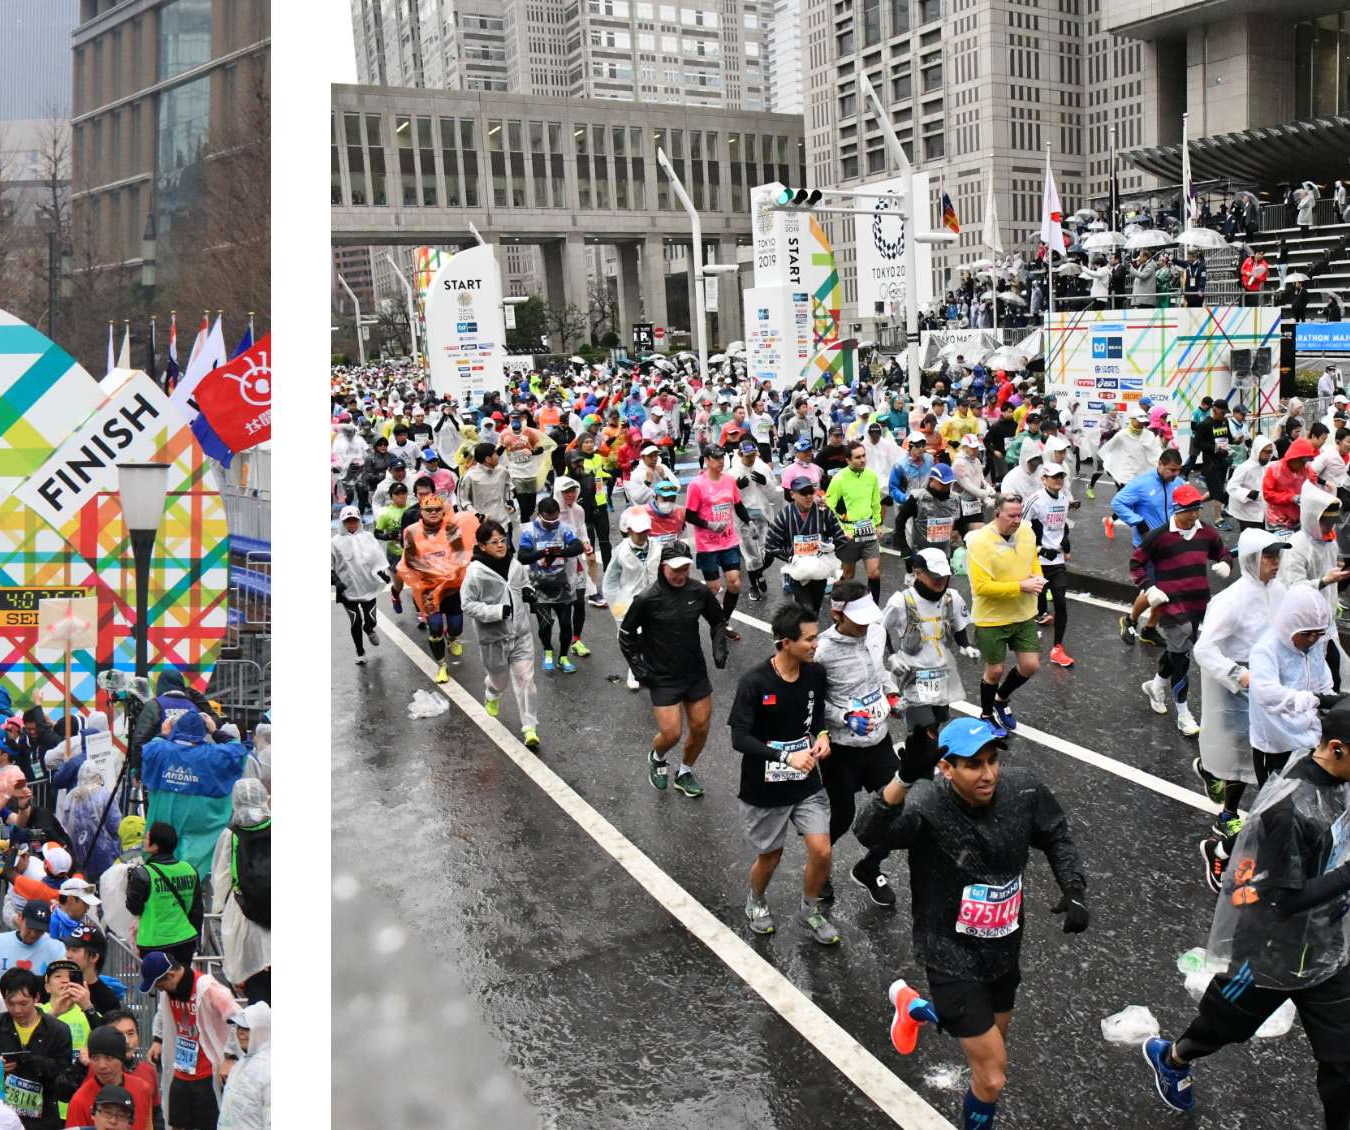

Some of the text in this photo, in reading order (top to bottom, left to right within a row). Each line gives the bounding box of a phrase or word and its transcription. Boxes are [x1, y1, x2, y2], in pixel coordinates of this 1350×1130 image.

[759, 254, 776, 268] 2019
[788, 238, 801, 285] START
[872, 265, 896, 279] TOKYO
[444, 280, 482, 290] START
[37, 392, 159, 512] FINISH
[6, 612, 39, 625] SEI
